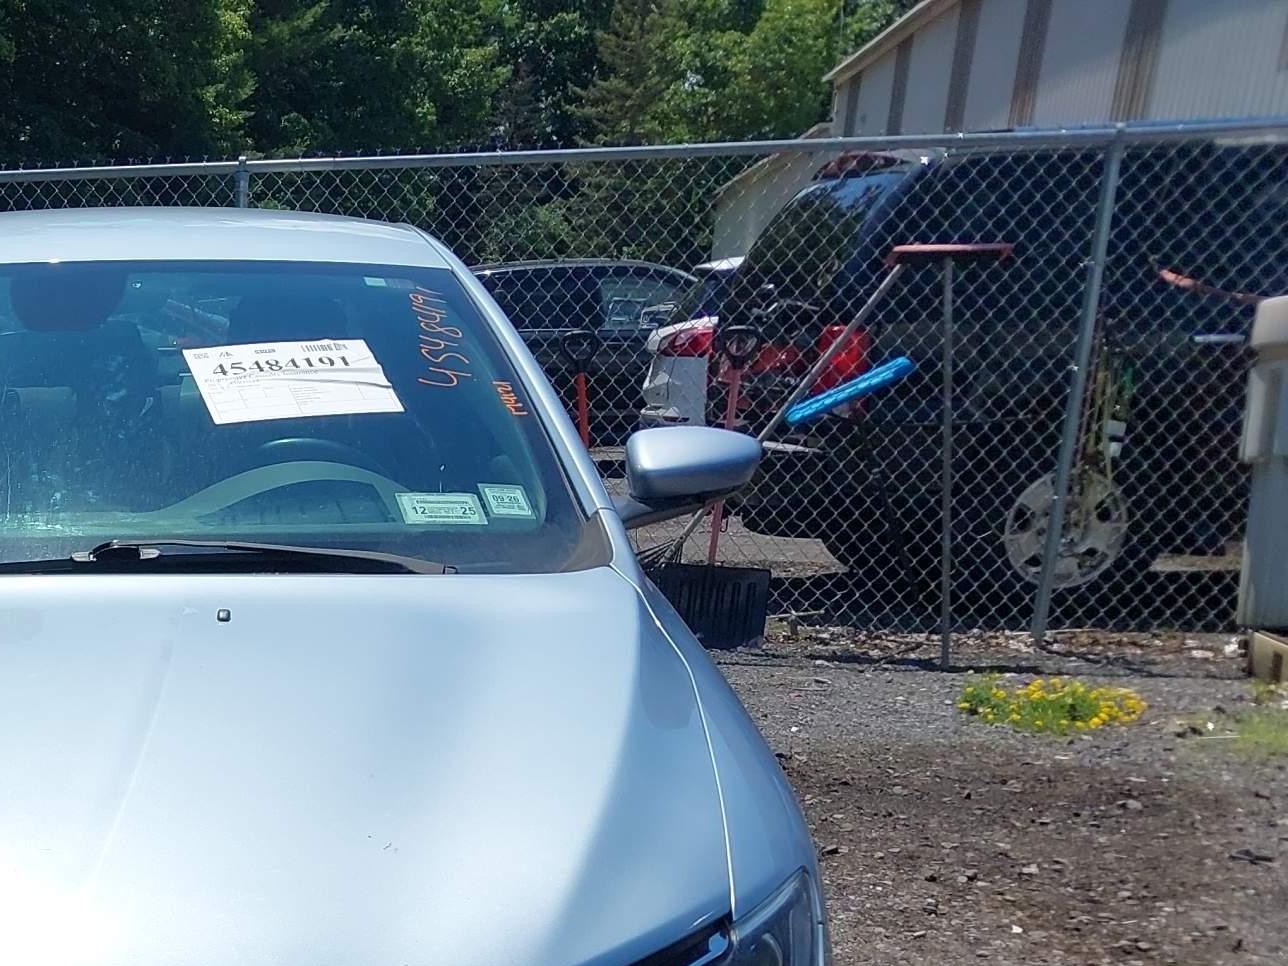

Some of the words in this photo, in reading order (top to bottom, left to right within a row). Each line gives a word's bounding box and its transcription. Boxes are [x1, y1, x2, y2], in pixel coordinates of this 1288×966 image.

[408, 286, 472, 388] 45484191
[212, 355, 351, 377] 45484191
[412, 506, 428, 515] 12
[460, 506, 476, 516] 25
